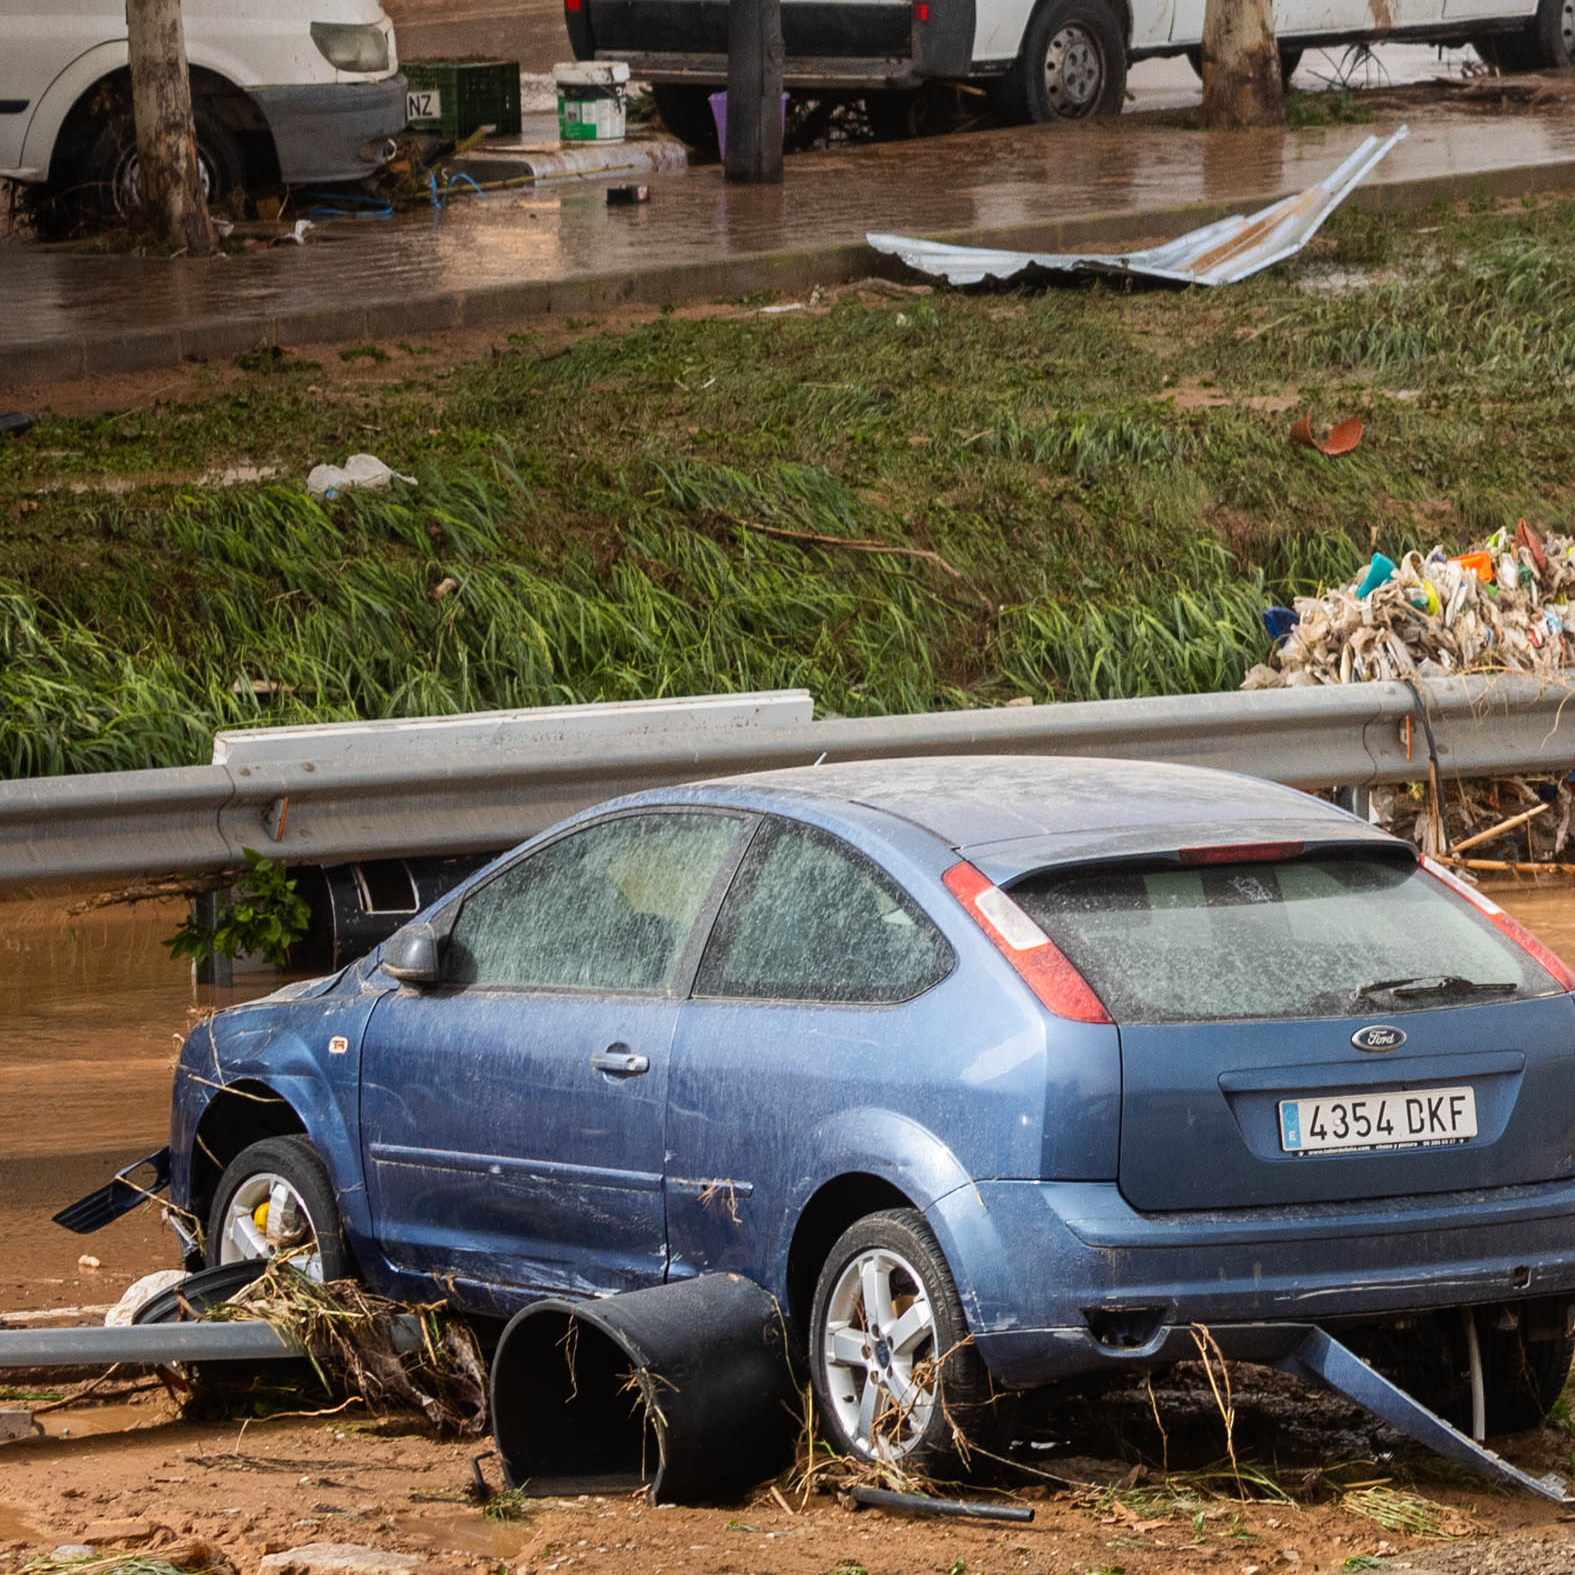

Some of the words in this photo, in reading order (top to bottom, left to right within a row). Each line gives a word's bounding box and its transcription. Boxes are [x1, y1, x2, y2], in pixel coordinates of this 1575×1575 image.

[1367, 1029, 1395, 1046] Ford
[1309, 1100, 1394, 1141] 4354
[1405, 1095, 1467, 1135] DKF
